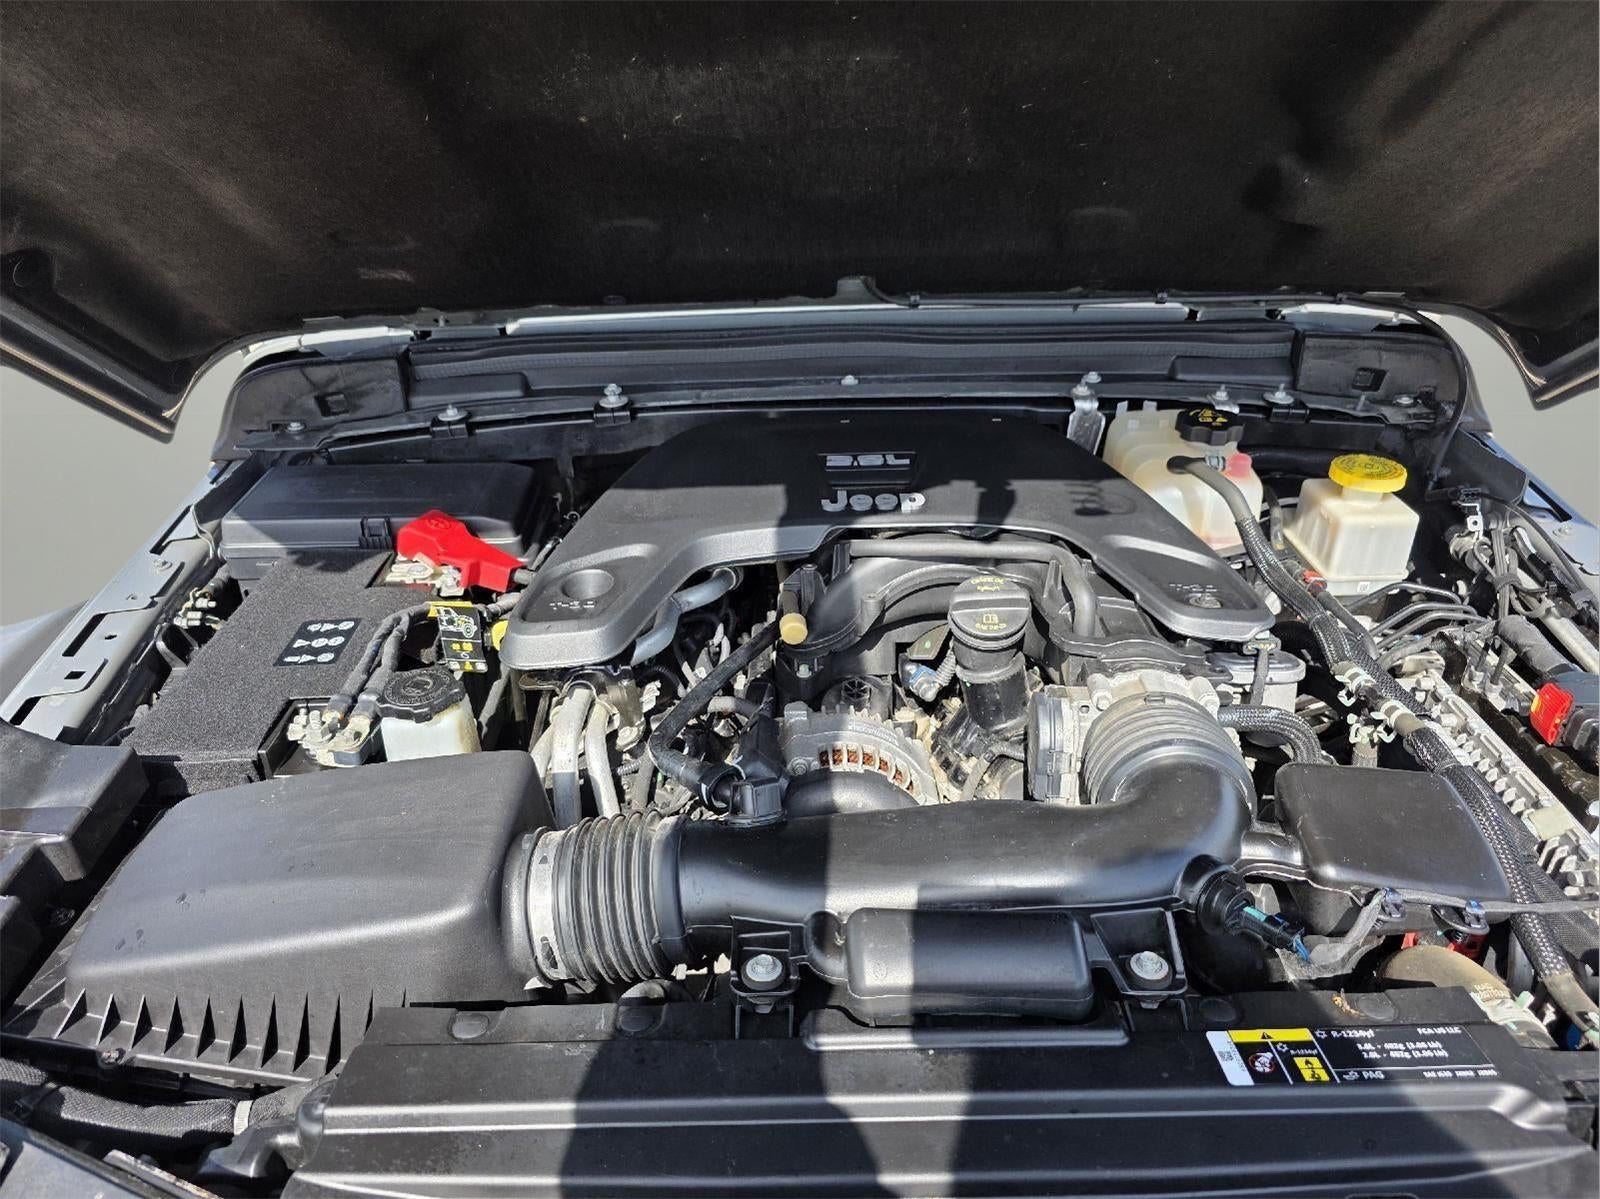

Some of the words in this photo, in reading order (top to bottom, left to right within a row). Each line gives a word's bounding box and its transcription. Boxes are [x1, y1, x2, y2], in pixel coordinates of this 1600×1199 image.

[821, 489, 926, 513] Jeep
[1331, 1028, 1375, 1039] R-1234yf
[1417, 1027, 1435, 1035] FCA
[1446, 1026, 1462, 1034] LLC
[1362, 1070, 1385, 1080] PAG
